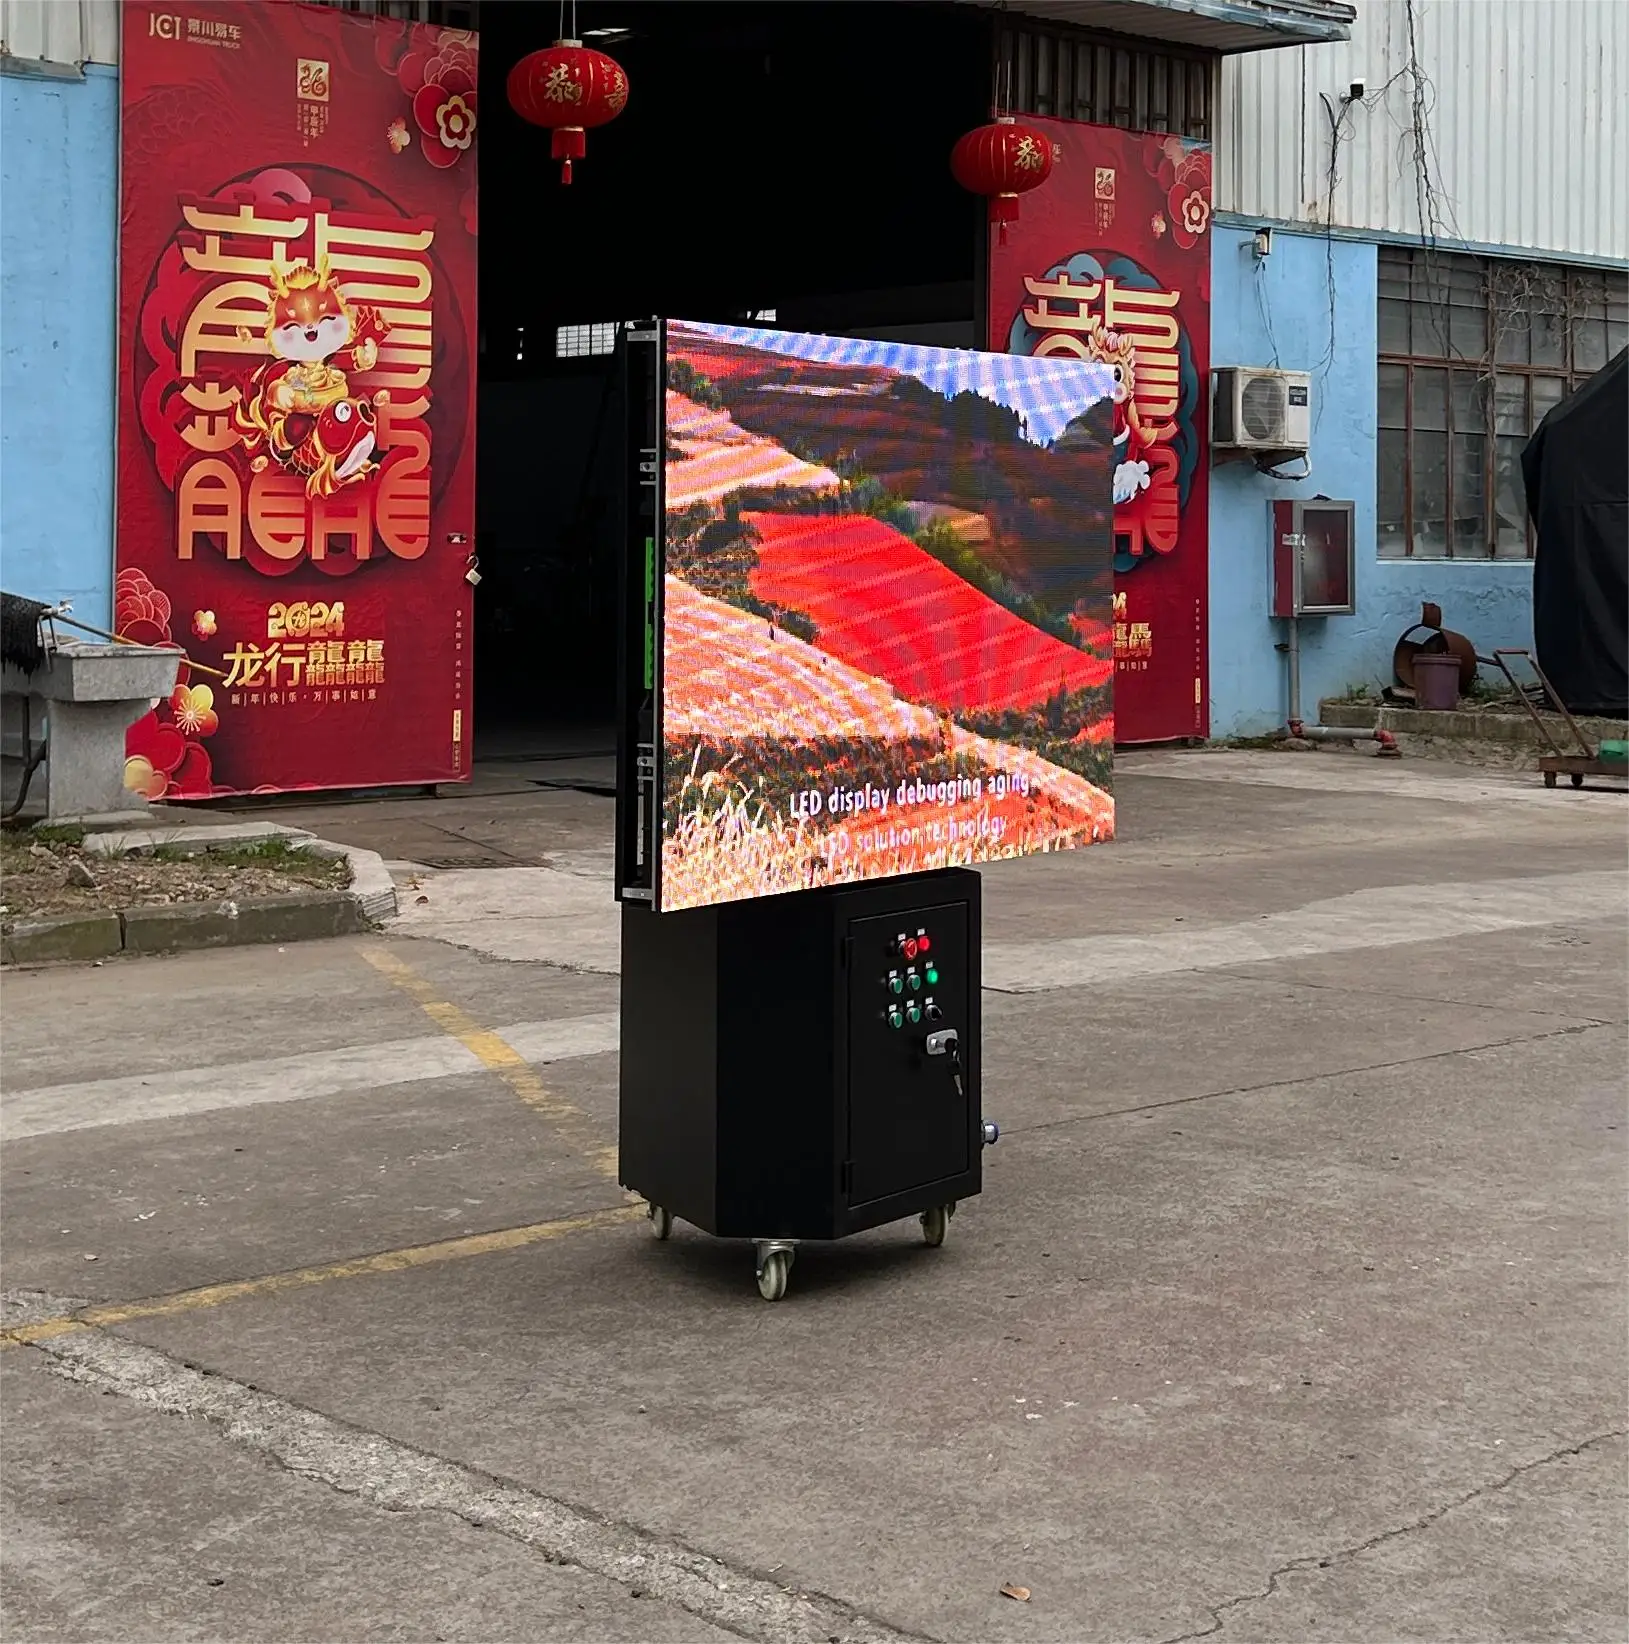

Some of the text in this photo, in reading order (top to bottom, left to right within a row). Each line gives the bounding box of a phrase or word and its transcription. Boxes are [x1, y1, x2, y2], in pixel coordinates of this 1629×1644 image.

[187, 18, 242, 40] 景川易车
[267, 601, 345, 639] 2024
[790, 774, 1029, 819] LED display debugging aging
